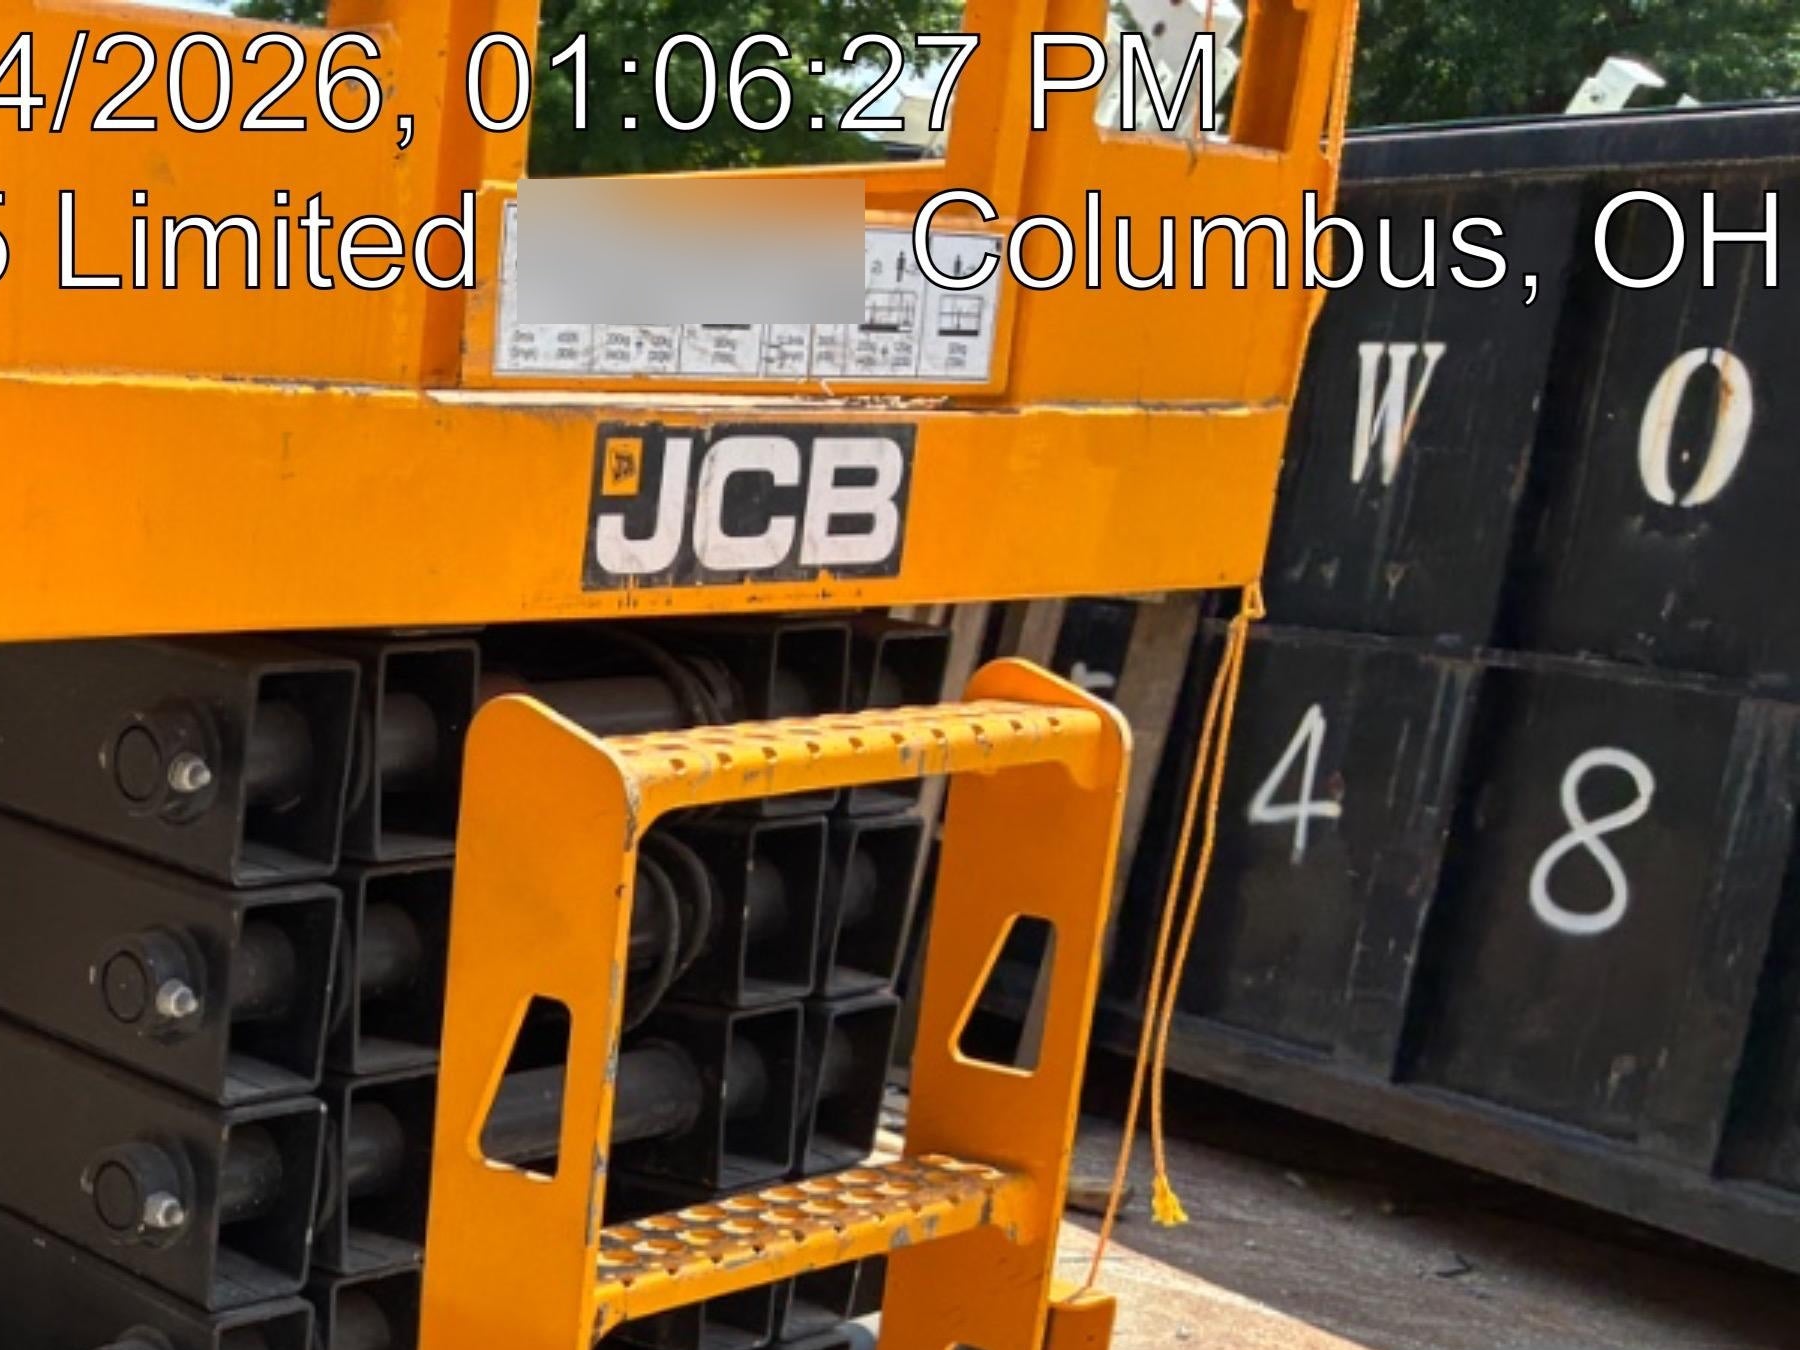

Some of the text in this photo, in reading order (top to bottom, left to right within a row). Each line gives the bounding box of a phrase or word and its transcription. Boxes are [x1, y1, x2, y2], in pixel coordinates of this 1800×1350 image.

[1351, 342, 1446, 484] W
[596, 437, 903, 574] JCB
[1248, 703, 1655, 935] 4 8
